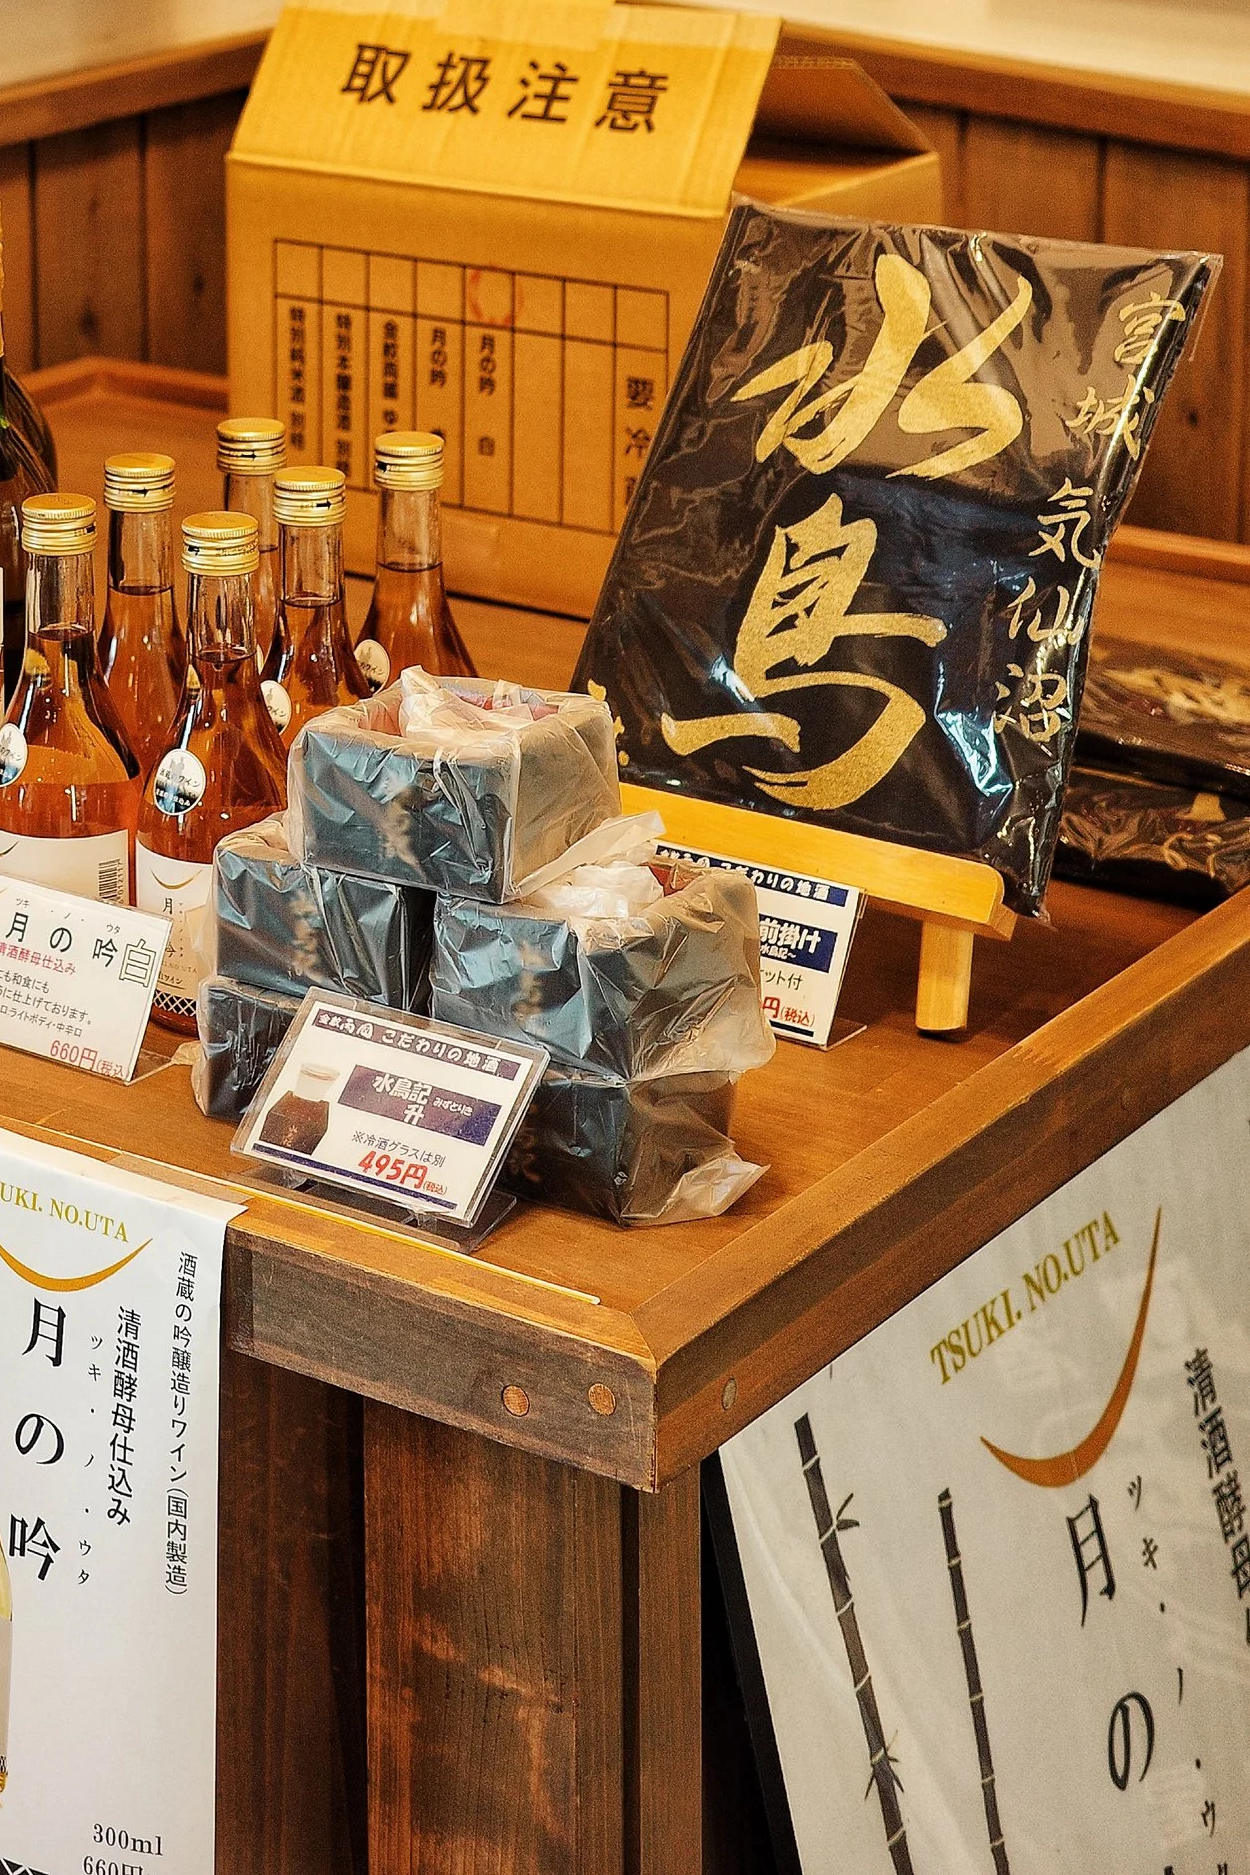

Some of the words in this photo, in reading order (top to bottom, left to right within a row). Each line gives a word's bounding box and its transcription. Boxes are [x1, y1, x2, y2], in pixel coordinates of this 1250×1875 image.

[341, 43, 669, 133] 取扱注意
[16, 897, 30, 908] ツキ
[760, 968, 803, 992] ット付
[381, 1027, 501, 1075] こだわりの地酒
[372, 1073, 434, 1105] 水鳥記
[433, 1096, 474, 1117] みずとりき
[404, 1103, 425, 1126] 升
[50, 1197, 130, 1244] NO.UTA
[106, 1304, 142, 1526] 清酒酵母仕込み
[7, 1296, 68, 1582] 月の吟
[1183, 1346, 1250, 1645] 清酒酵母
[93, 1823, 163, 1856] 300ml
